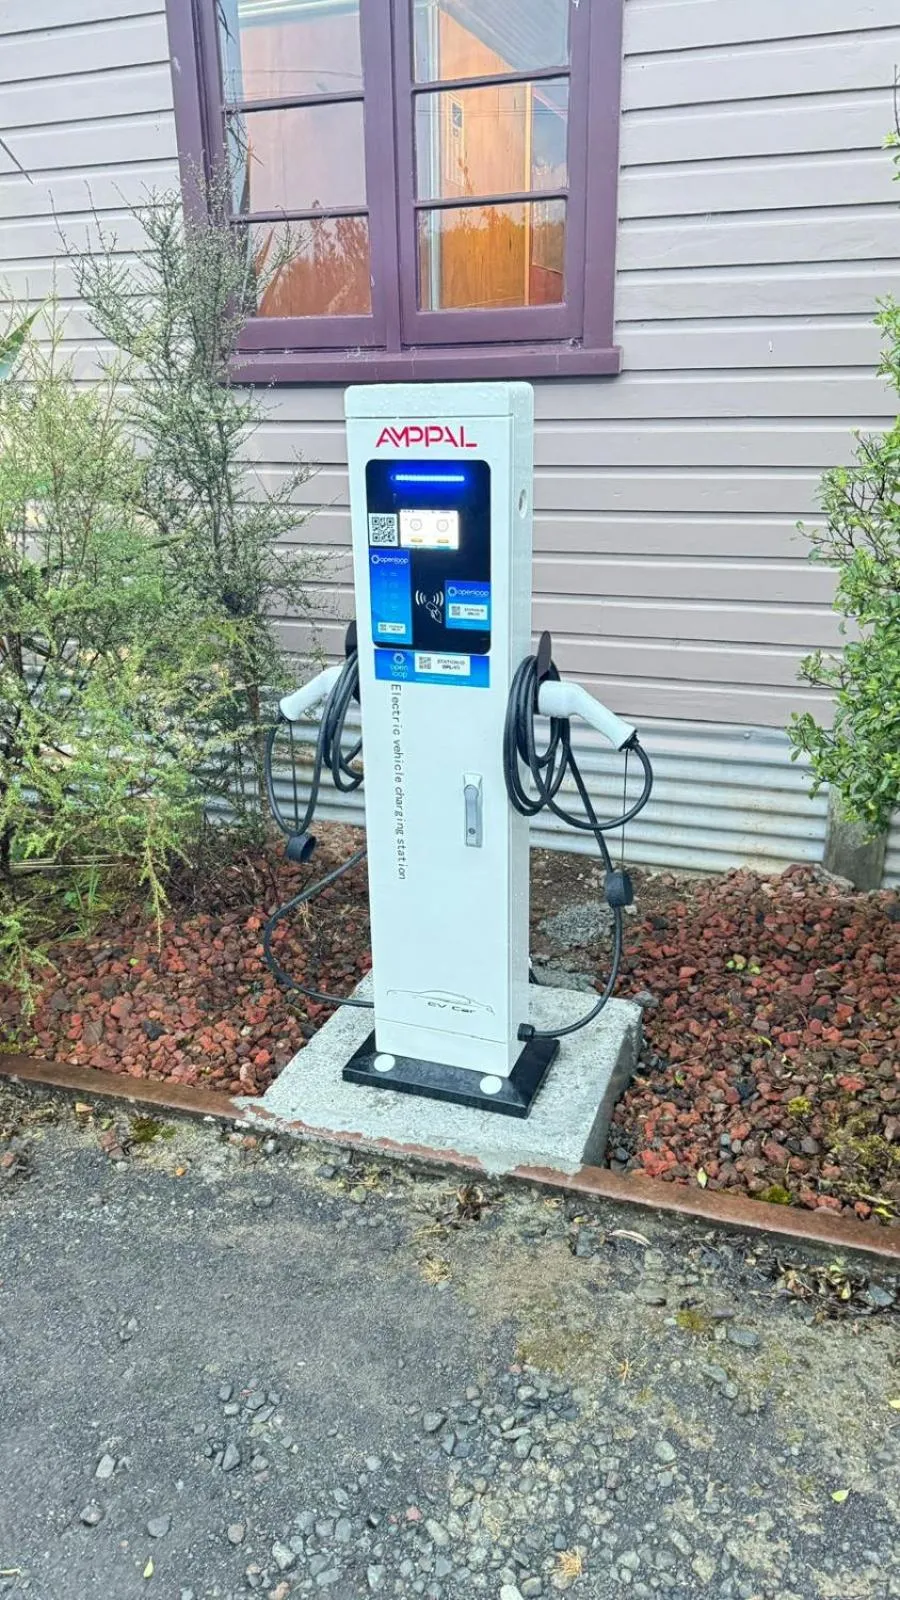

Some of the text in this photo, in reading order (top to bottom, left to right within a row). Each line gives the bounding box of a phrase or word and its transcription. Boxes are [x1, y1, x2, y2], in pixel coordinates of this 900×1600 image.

[375, 426, 478, 448] AMPPAL
[390, 664, 409, 672] open
[391, 671, 408, 680] loop
[390, 684, 408, 880] Electric vehicle charging station
